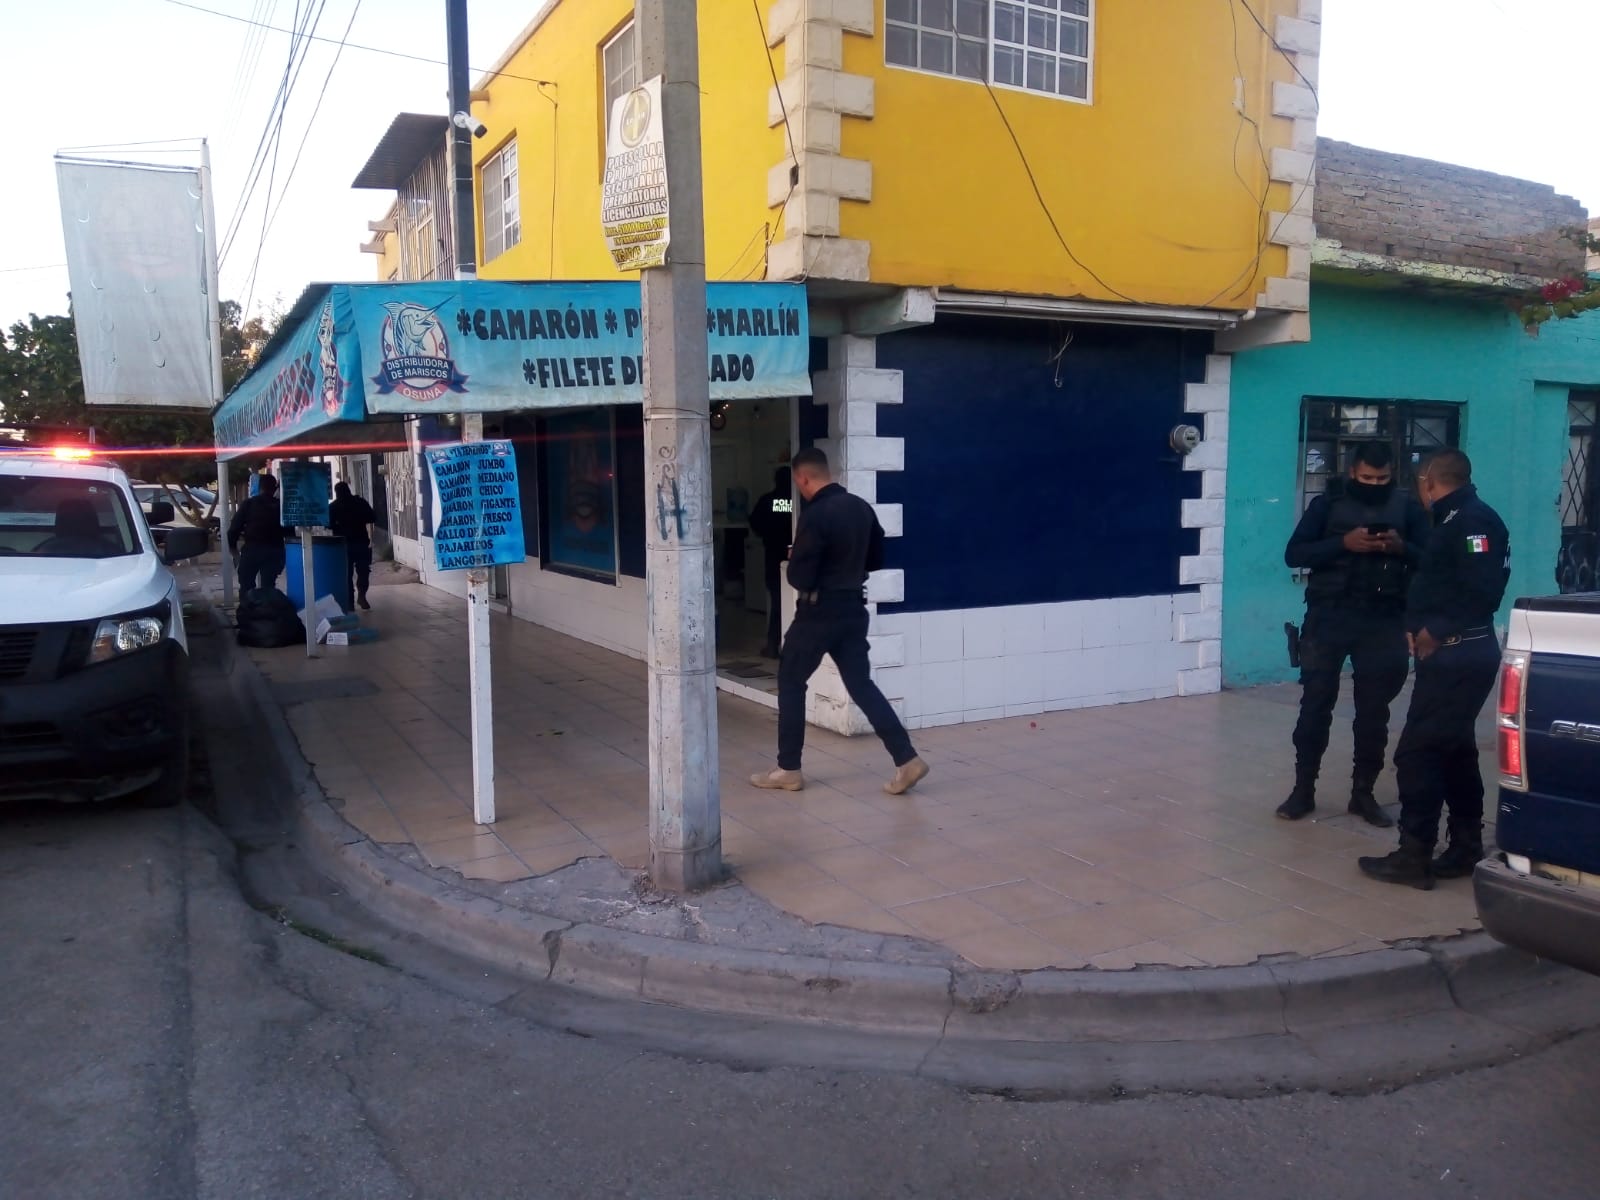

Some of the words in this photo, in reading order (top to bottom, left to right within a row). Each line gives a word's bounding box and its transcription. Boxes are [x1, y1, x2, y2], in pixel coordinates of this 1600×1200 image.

[603, 185, 667, 209] PREPARATORIA
[602, 200, 668, 223] LICENCIATURAS
[386, 358, 449, 371] DISTRIBUIDORA
[391, 369, 403, 380] DE
[404, 367, 448, 379] MARISCOS
[402, 386, 442, 400] OSUNA
[477, 458, 505, 470] JUMBO
[478, 471, 515, 483] MEDIANO
[480, 485, 504, 496] CHICO
[480, 498, 516, 509] GIGANTE
[483, 512, 512, 523] FRESCO
[437, 527, 466, 540] CALLO
[481, 525, 506, 537] ACHA
[438, 539, 494, 554] PAJARITOS
[441, 553, 495, 568] LANGOSTA
